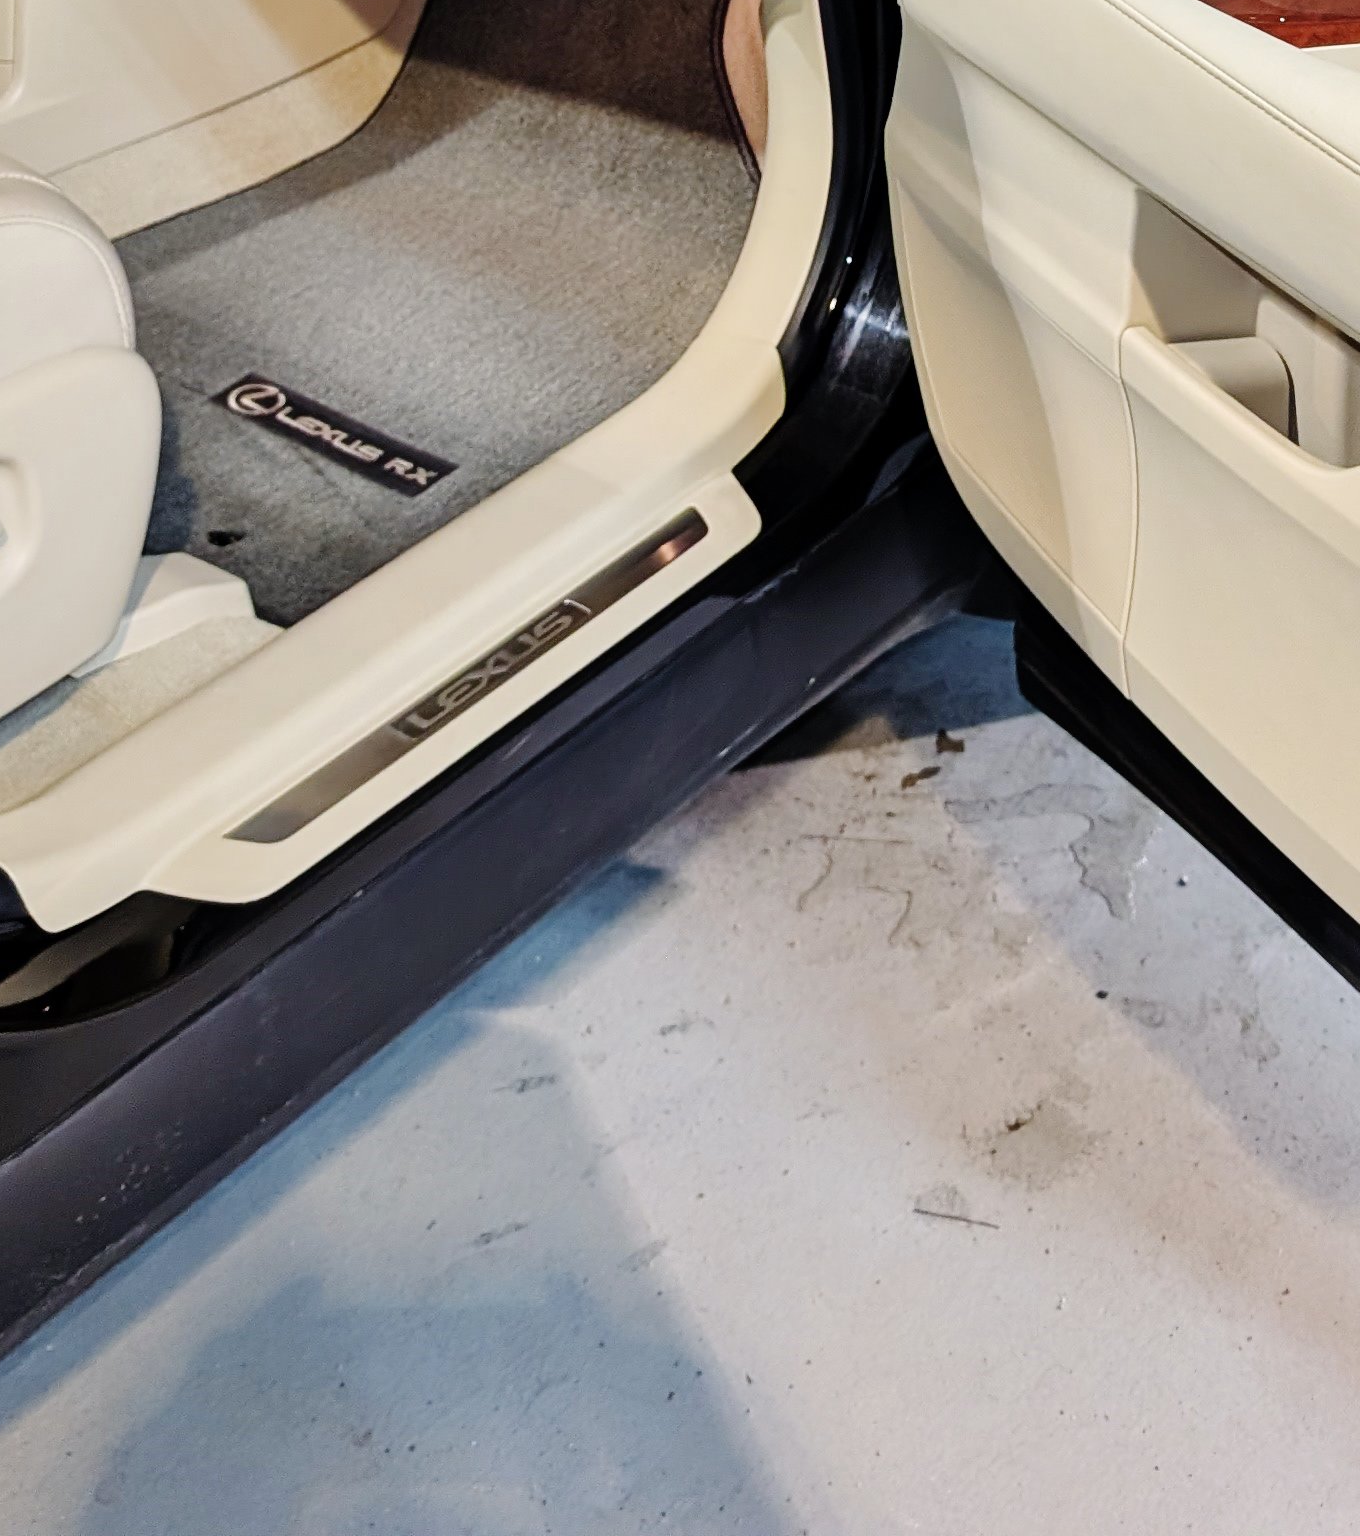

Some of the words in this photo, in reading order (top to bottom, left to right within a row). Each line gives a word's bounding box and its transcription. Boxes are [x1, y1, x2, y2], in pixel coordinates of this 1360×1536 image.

[275, 406, 384, 462] LEXUS
[383, 457, 438, 486] RX
[404, 611, 574, 729] LEXUS
